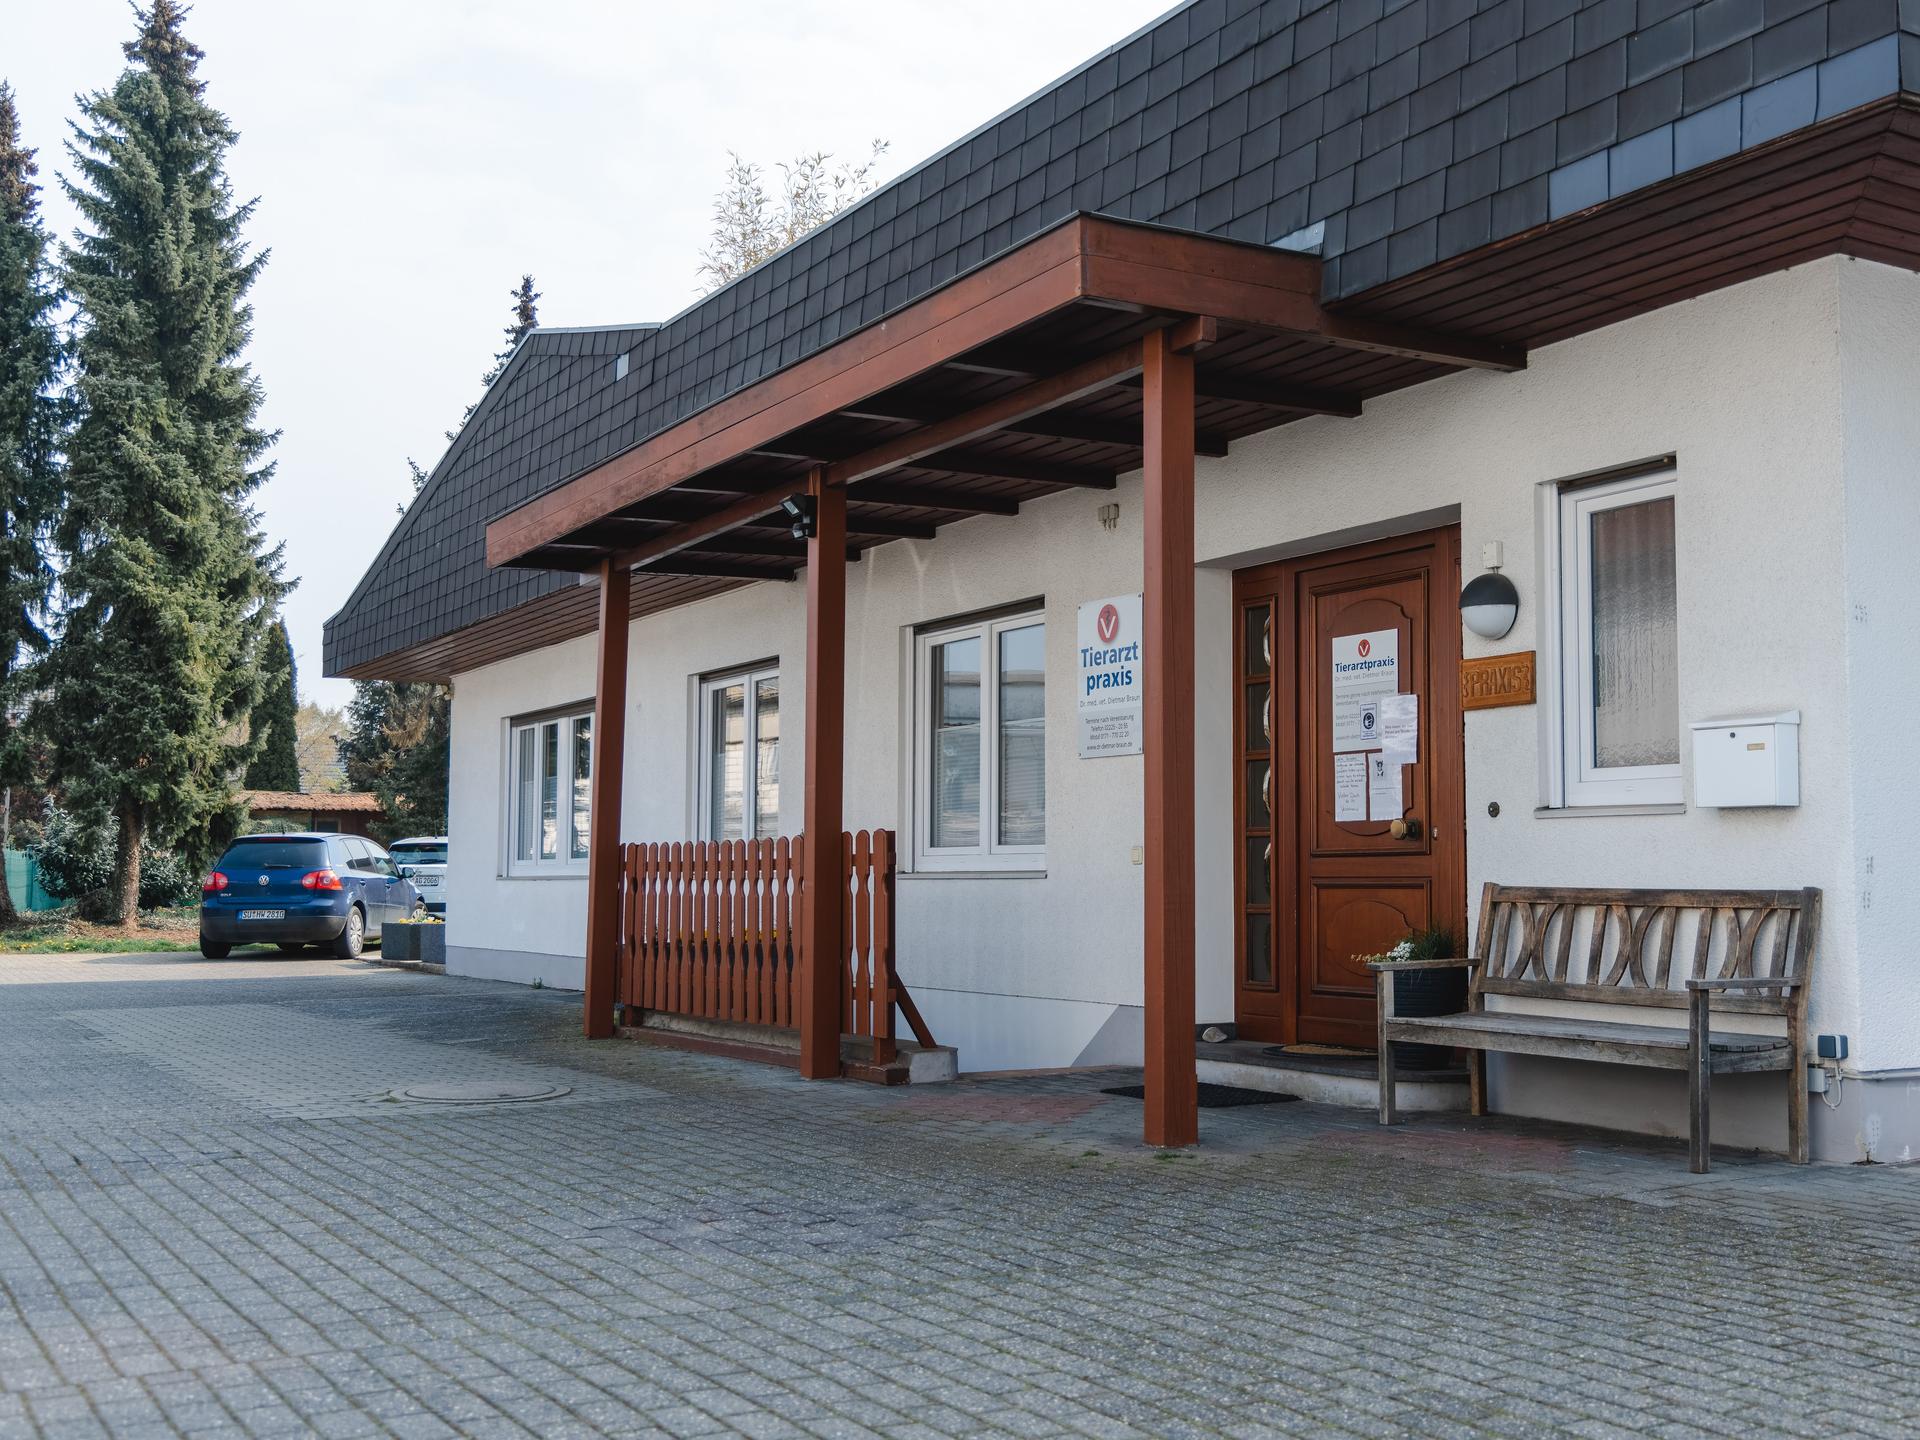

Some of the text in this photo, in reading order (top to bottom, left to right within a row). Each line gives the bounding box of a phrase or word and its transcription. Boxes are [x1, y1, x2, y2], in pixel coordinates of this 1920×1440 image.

[1081, 641, 1138, 668] Tierarzt
[1335, 656, 1395, 672] Tierarztpraxis
[1087, 665, 1132, 696] praxis
[1470, 665, 1522, 697] PRAXIS
